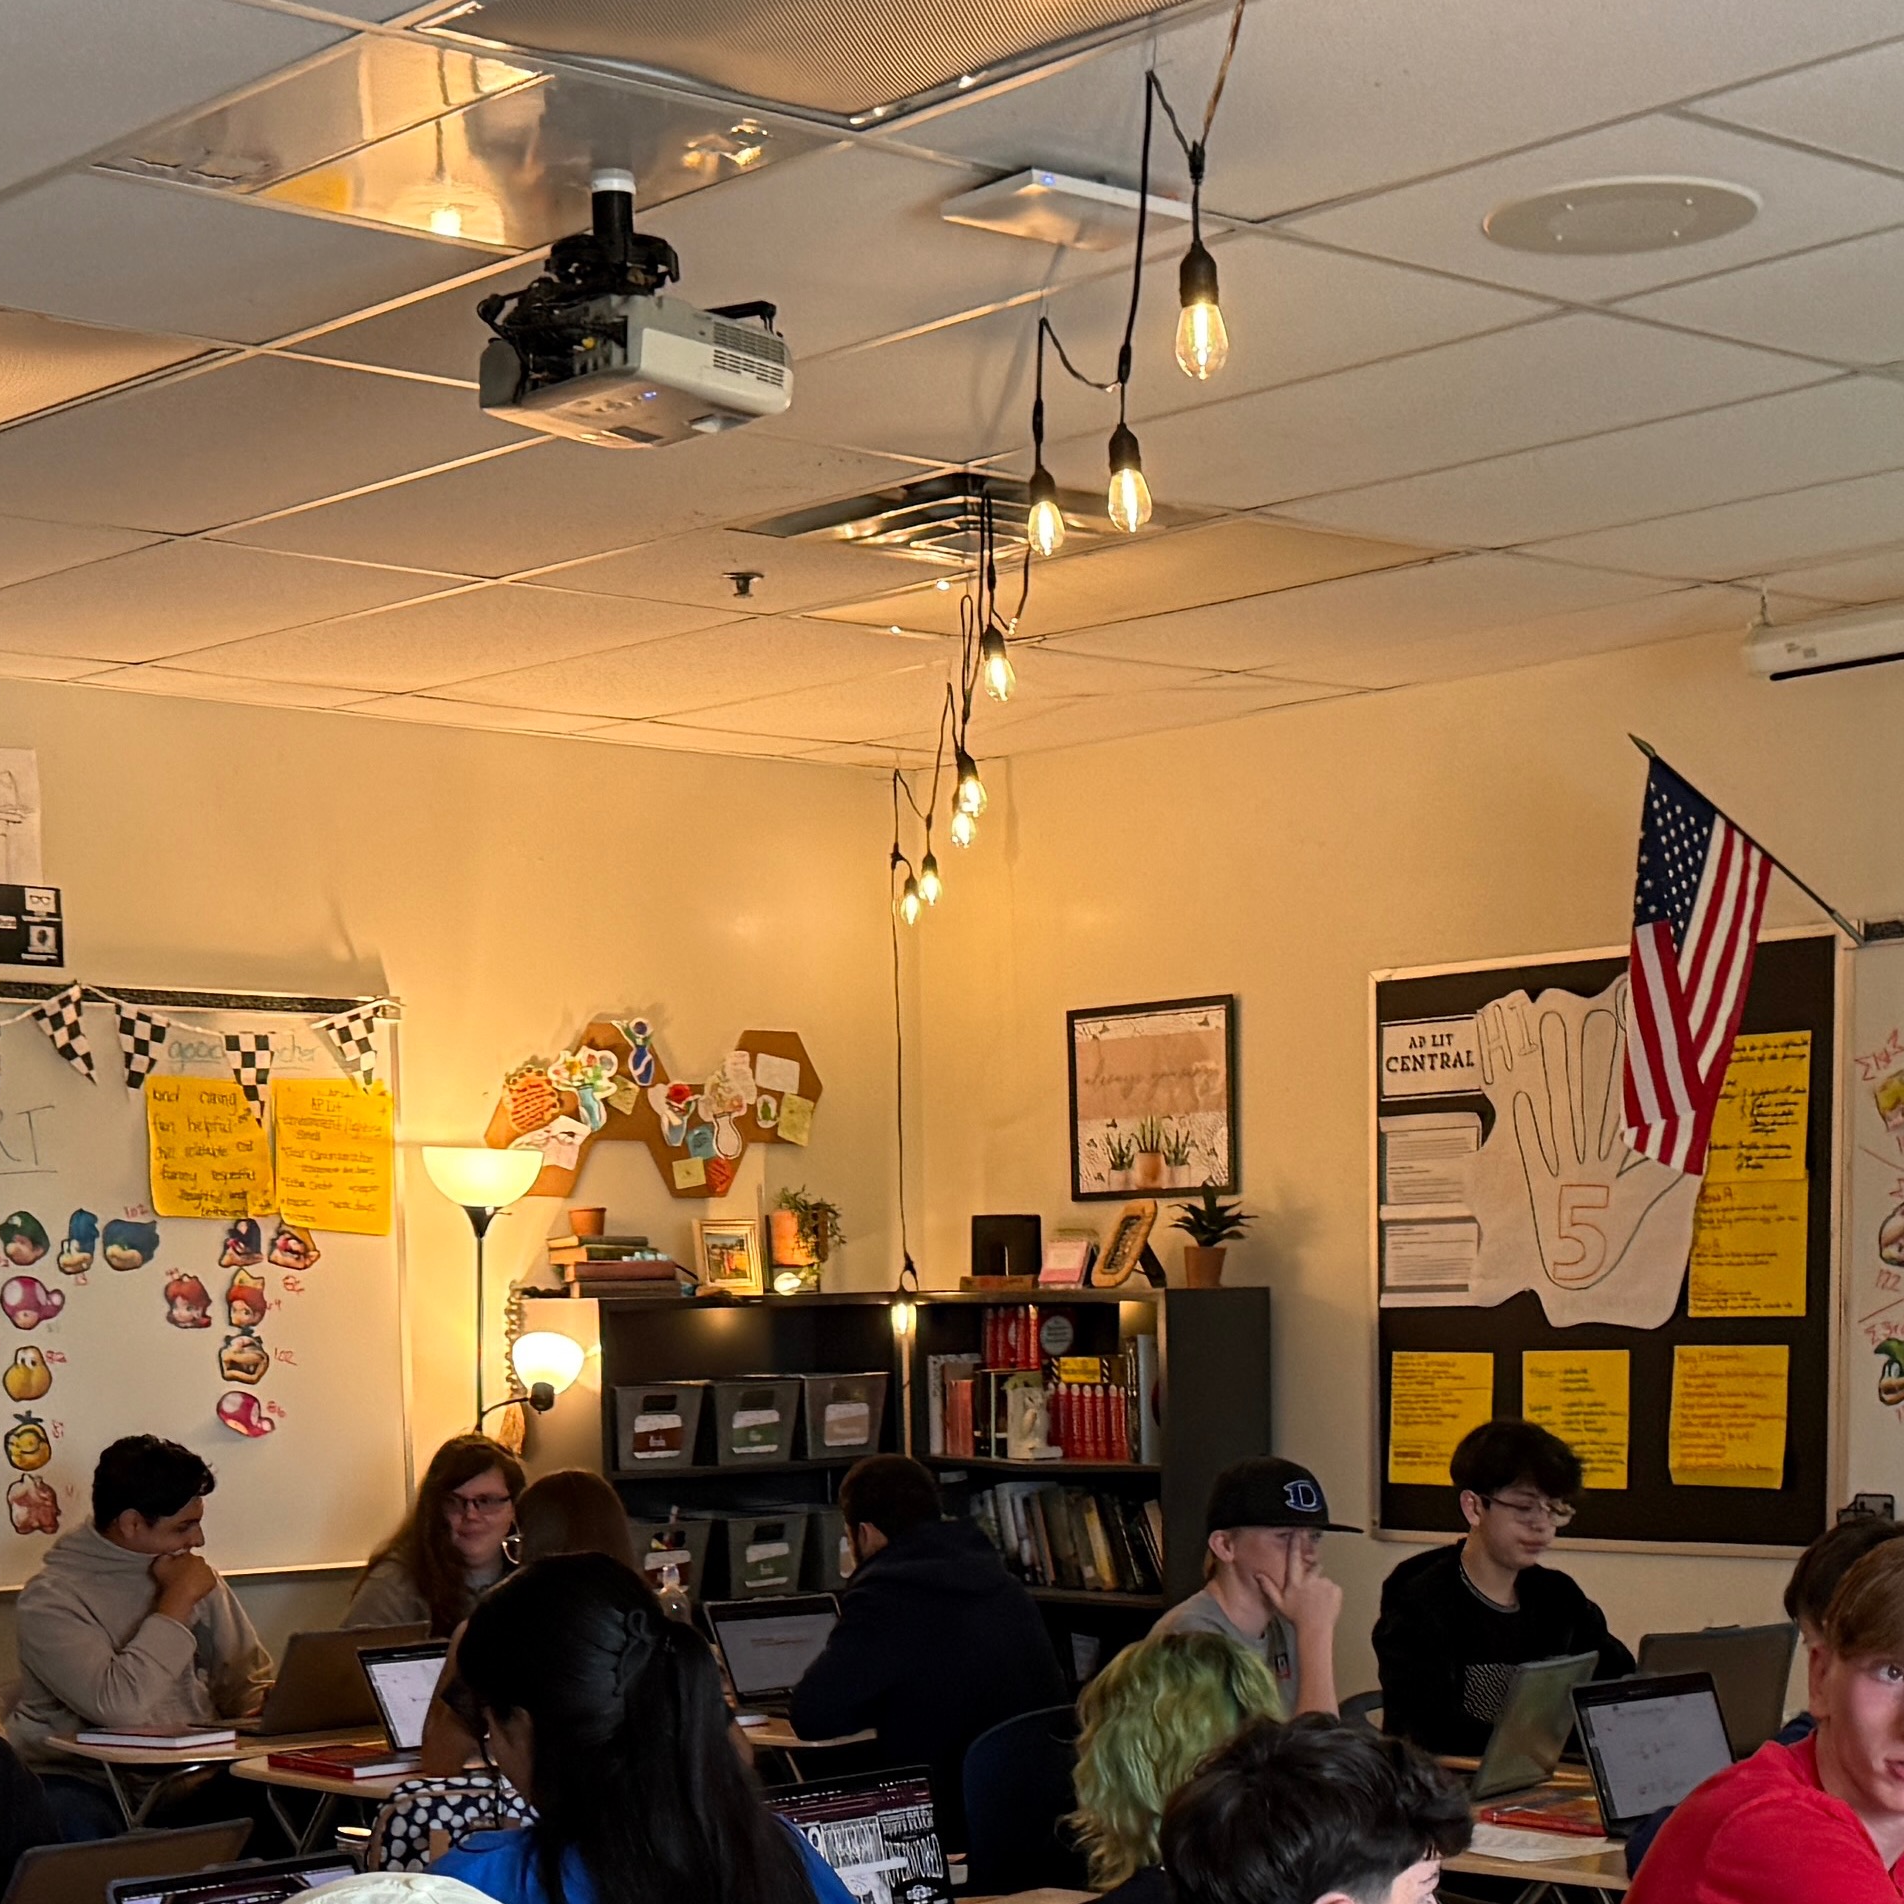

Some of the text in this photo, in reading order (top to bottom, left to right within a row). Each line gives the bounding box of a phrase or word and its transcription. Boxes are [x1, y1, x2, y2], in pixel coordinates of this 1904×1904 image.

[1408, 1032, 1454, 1050] AP LIT
[1385, 1049, 1475, 1074] CENTRAL
[1552, 1184, 1611, 1281] 5
[1285, 1479, 1326, 1513] D
